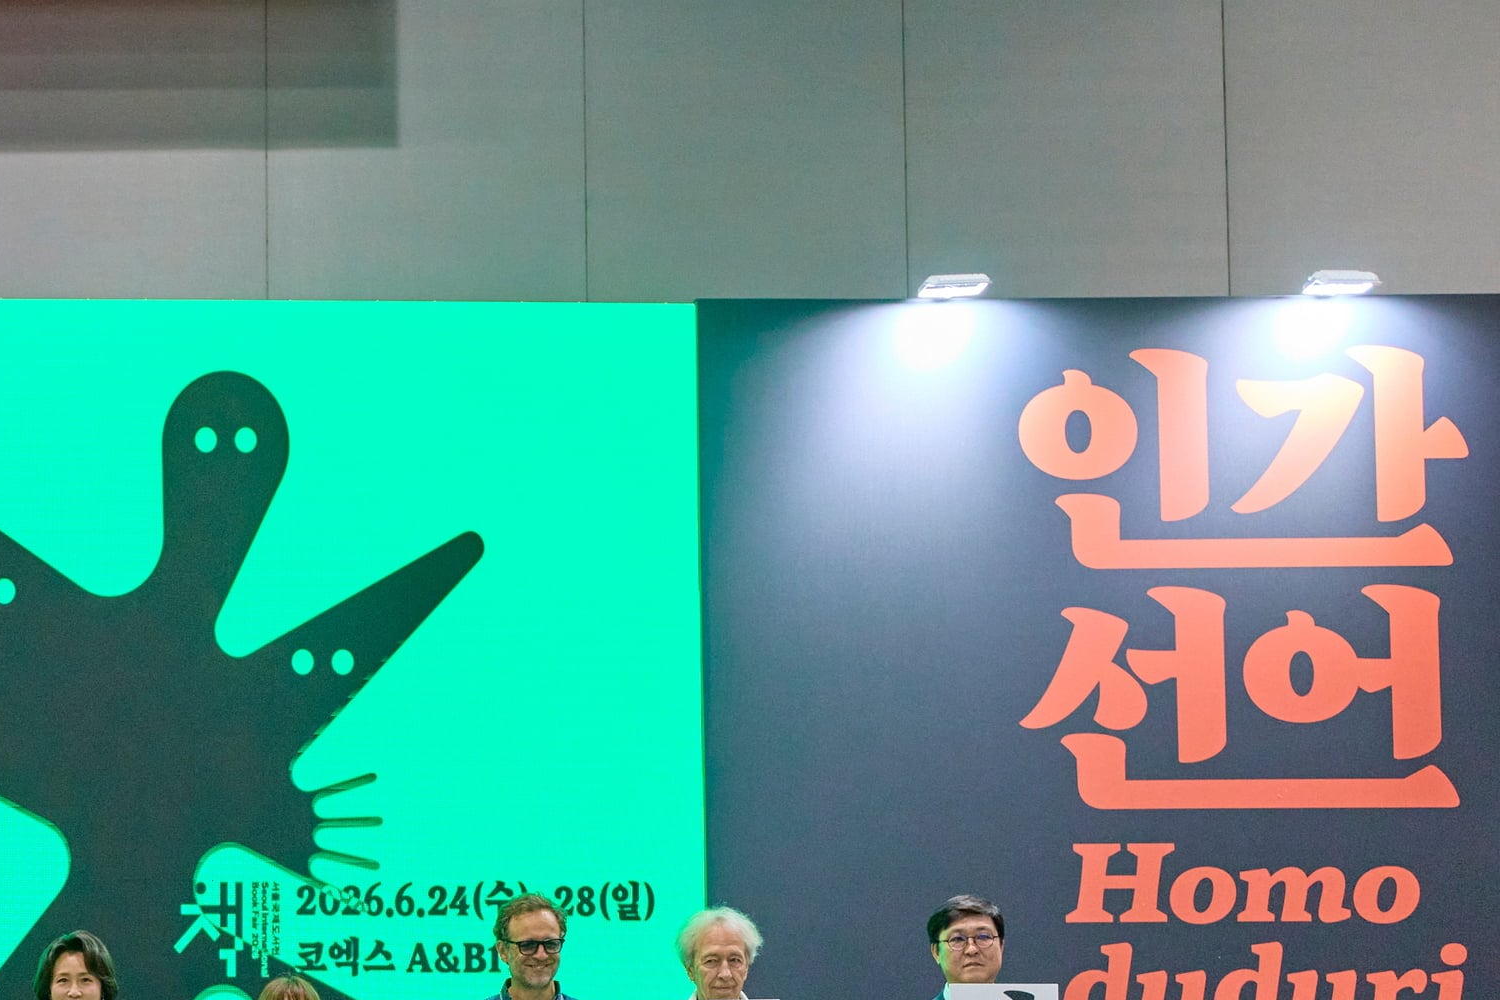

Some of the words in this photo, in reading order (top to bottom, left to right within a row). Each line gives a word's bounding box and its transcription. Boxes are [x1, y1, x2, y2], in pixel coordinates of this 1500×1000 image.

[251, 881, 260, 907] Book
[1064, 842, 1421, 925] Homo
[295, 936, 396, 978] 코엑스
